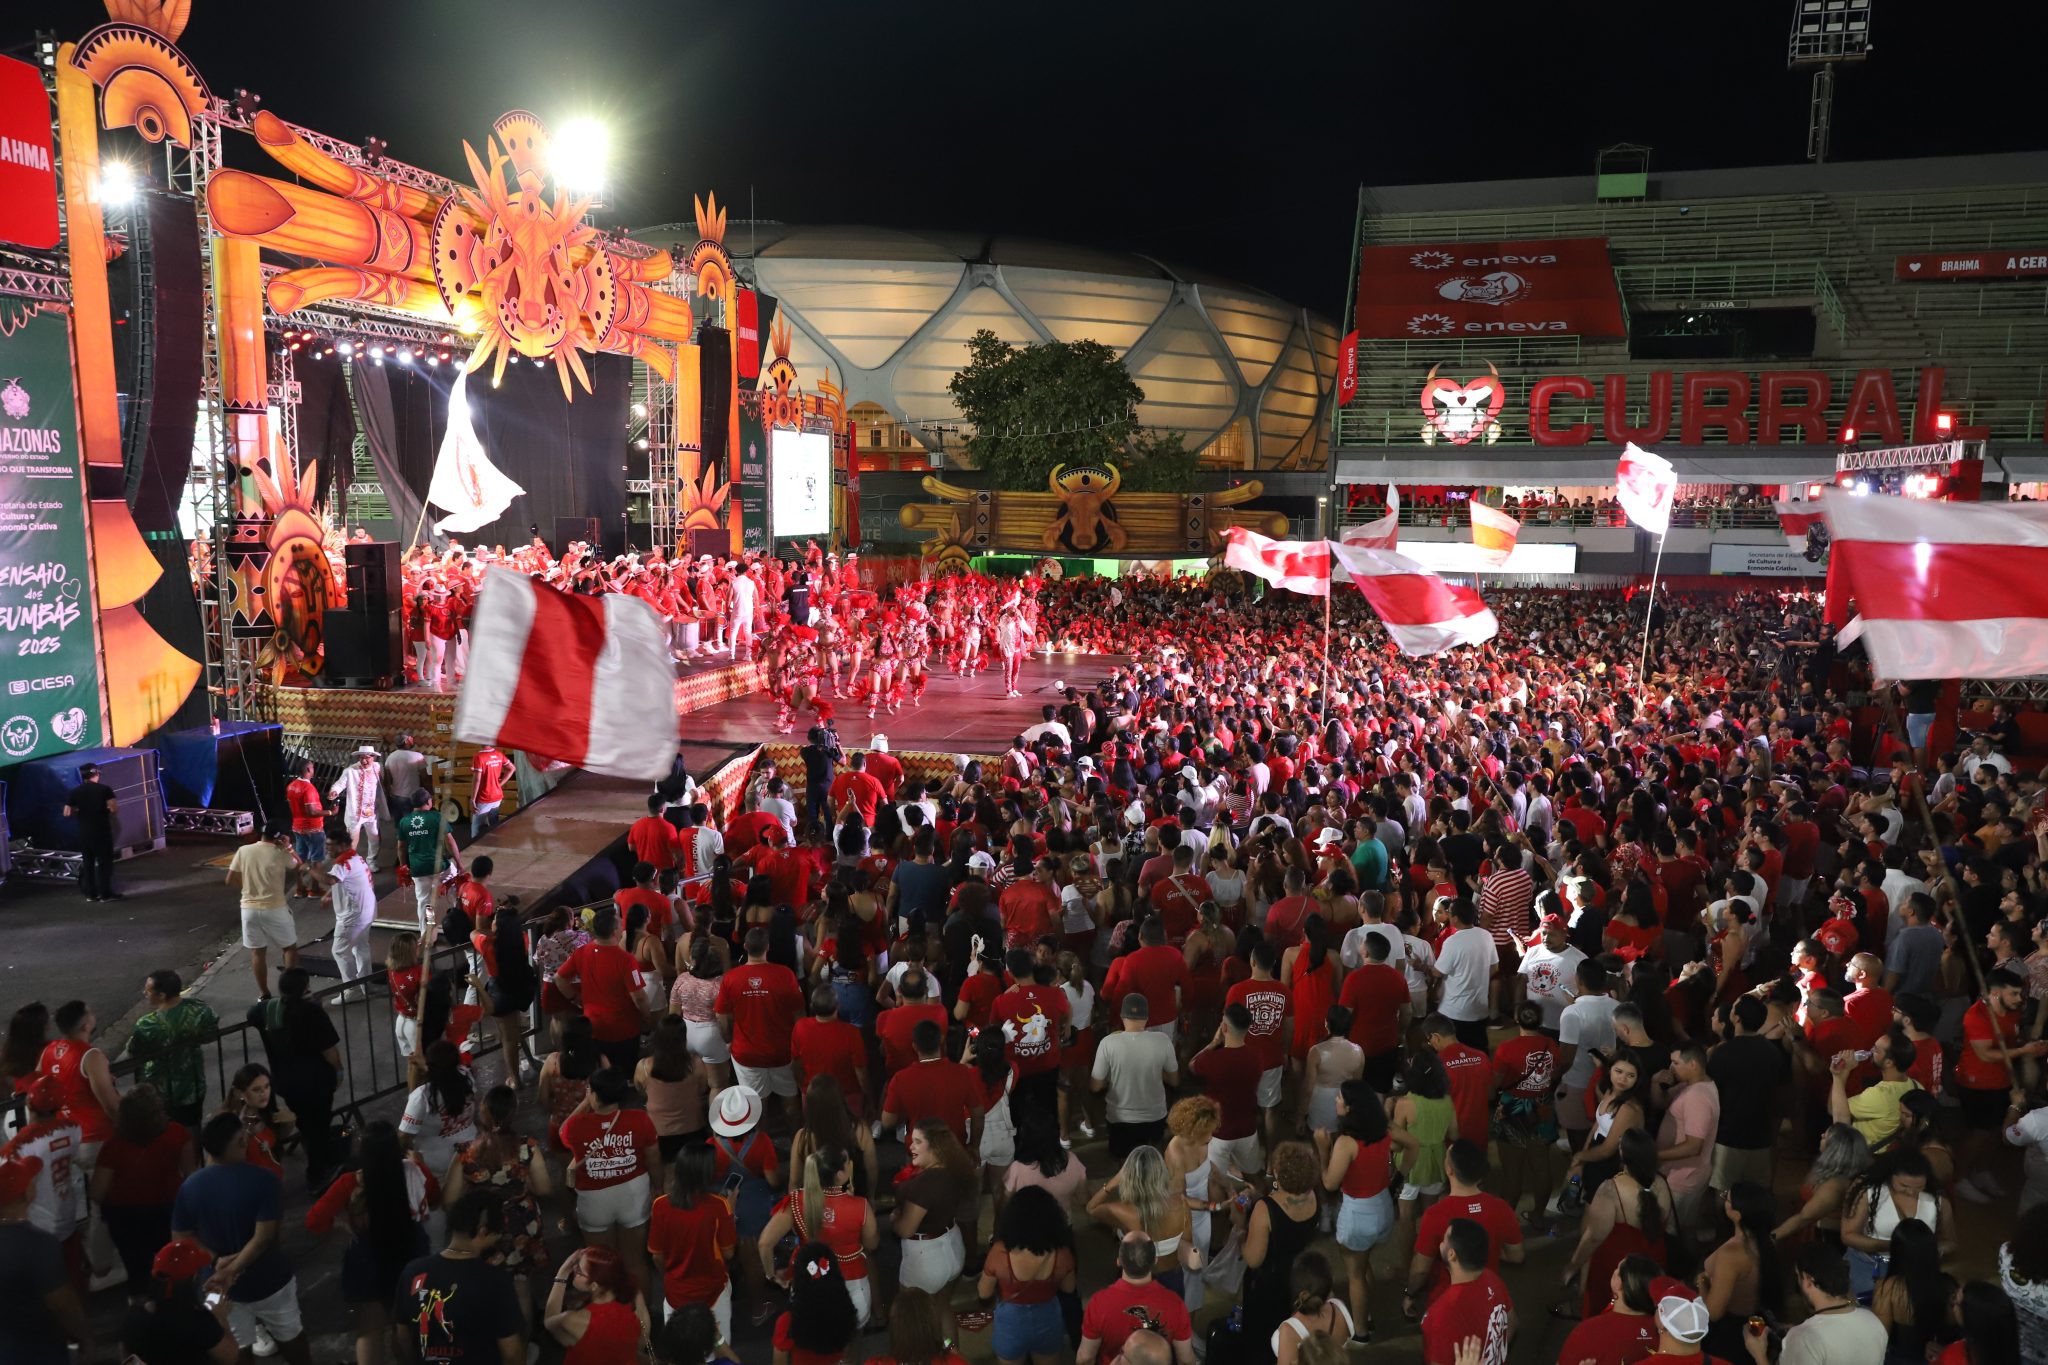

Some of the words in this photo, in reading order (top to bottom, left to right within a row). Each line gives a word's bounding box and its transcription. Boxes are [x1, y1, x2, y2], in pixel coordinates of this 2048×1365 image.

[1, 136, 50, 172] AHMA
[1462, 254, 1557, 267] eneva
[1941, 260, 1979, 272] BRAHMA
[2006, 258, 2016, 269] A
[1464, 321, 1568, 332] eneva
[1529, 367, 1990, 446] CURRAL
[26, 466, 73, 474] TRANSFORMA
[26, 501, 38, 509] de
[39, 501, 63, 509] Estado
[0, 512, 29, 520] Cultura
[28, 523, 57, 531] Criativa
[860, 528, 880, 540] TE
[24, 588, 43, 600] dos
[18, 636, 61, 656] 2025
[31, 675, 75, 691] CIESA
[2, 715, 36, 730] MOVIMENTO
[408, 829, 429, 837] eneva
[1248, 994, 1284, 1004] GARANTIDO
[1014, 1041, 1051, 1057] POVÃO
[1446, 1056, 1481, 1067] GARANTIDO
[603, 1131, 633, 1148] NASCI
